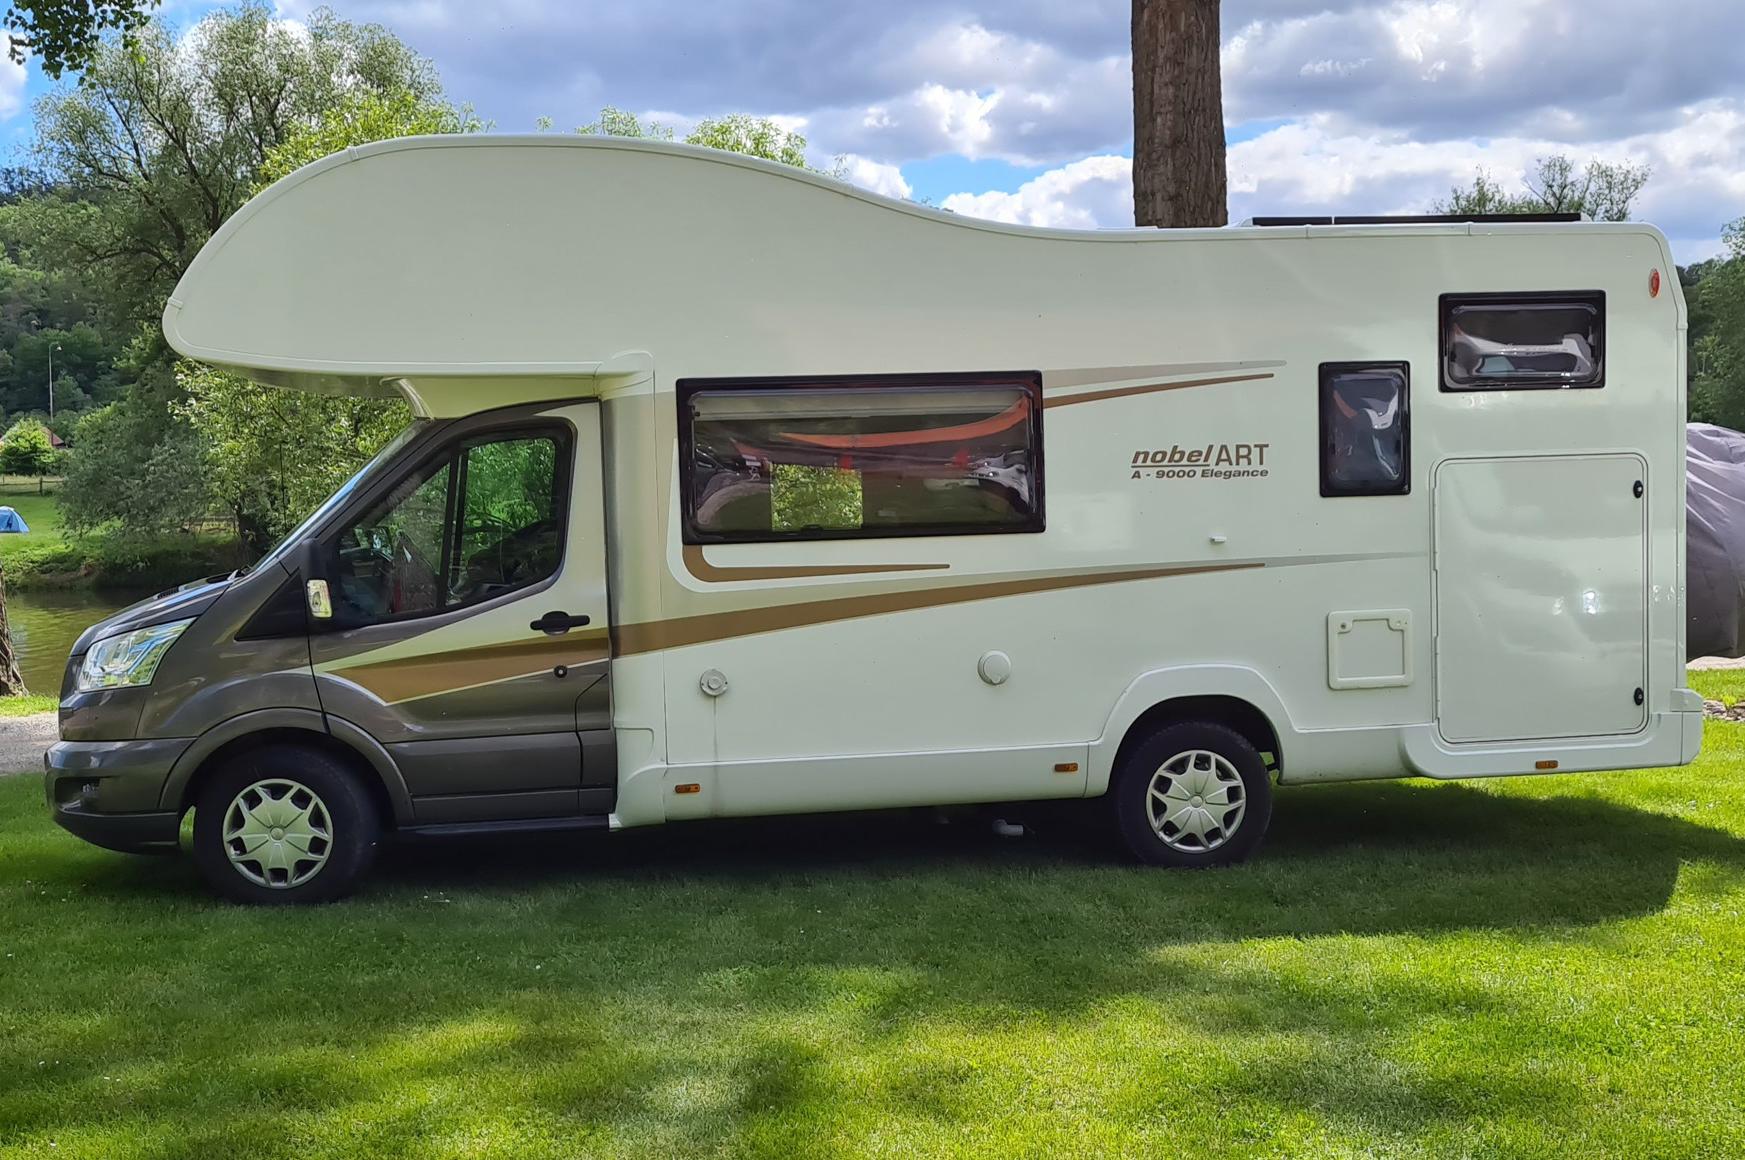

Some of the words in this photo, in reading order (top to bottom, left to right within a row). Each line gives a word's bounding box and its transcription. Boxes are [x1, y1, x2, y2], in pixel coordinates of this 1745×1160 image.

[1131, 470, 1142, 479] A
[1155, 469, 1197, 479] 9000
[1201, 468, 1269, 480] Elegance
